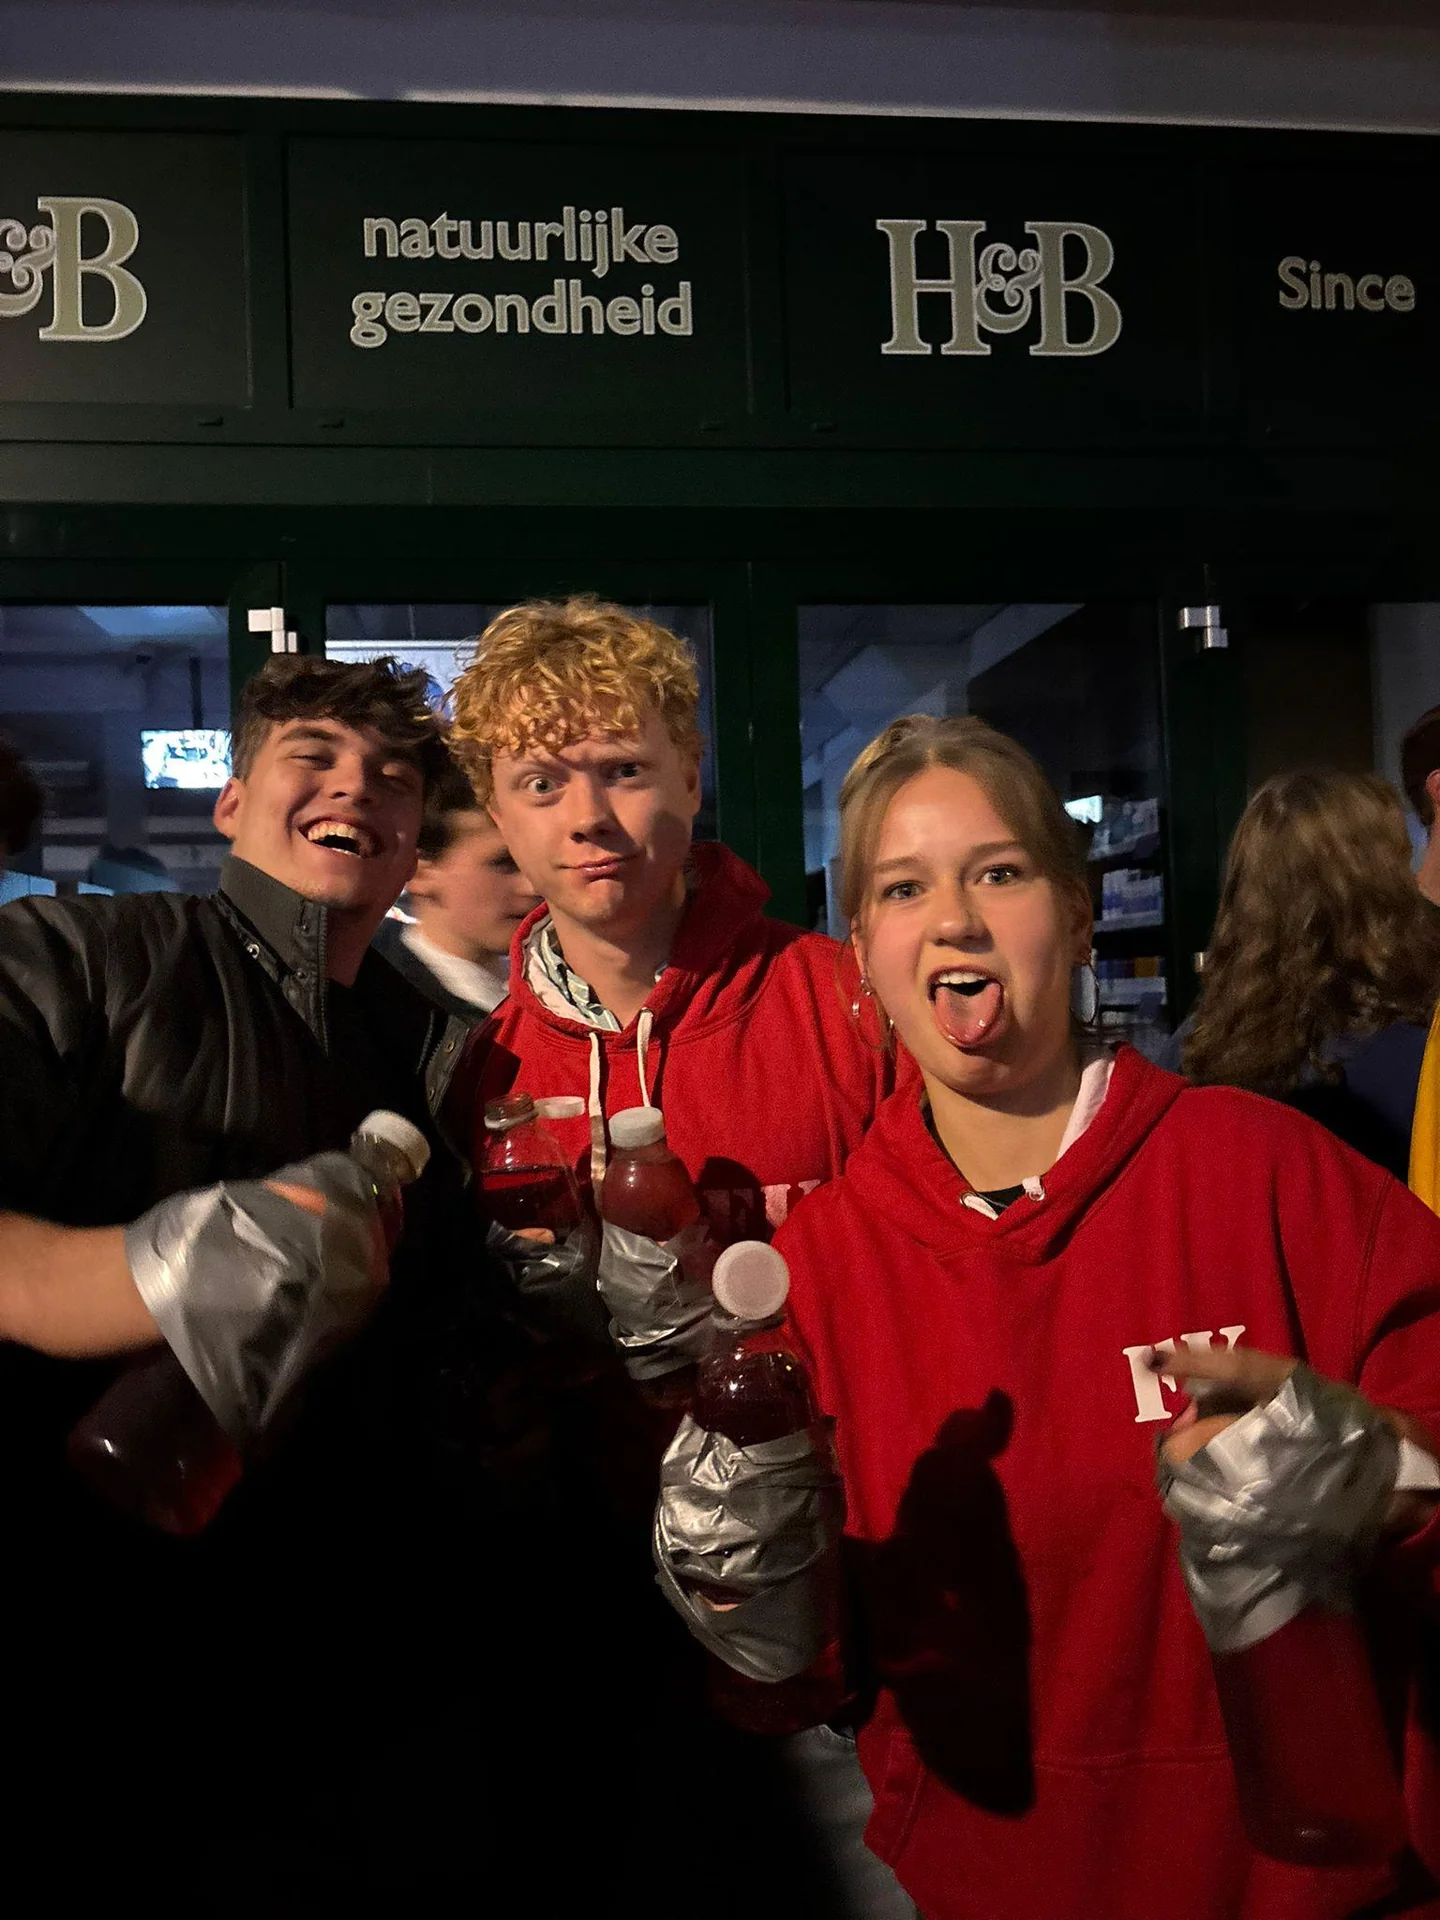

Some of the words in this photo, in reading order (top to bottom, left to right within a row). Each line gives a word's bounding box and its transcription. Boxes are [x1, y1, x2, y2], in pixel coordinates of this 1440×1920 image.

[363, 206, 680, 278] natuurlijke
[350, 279, 694, 349] gezondheid
[876, 219, 1123, 357] H&B
[1278, 256, 1417, 312] Since
